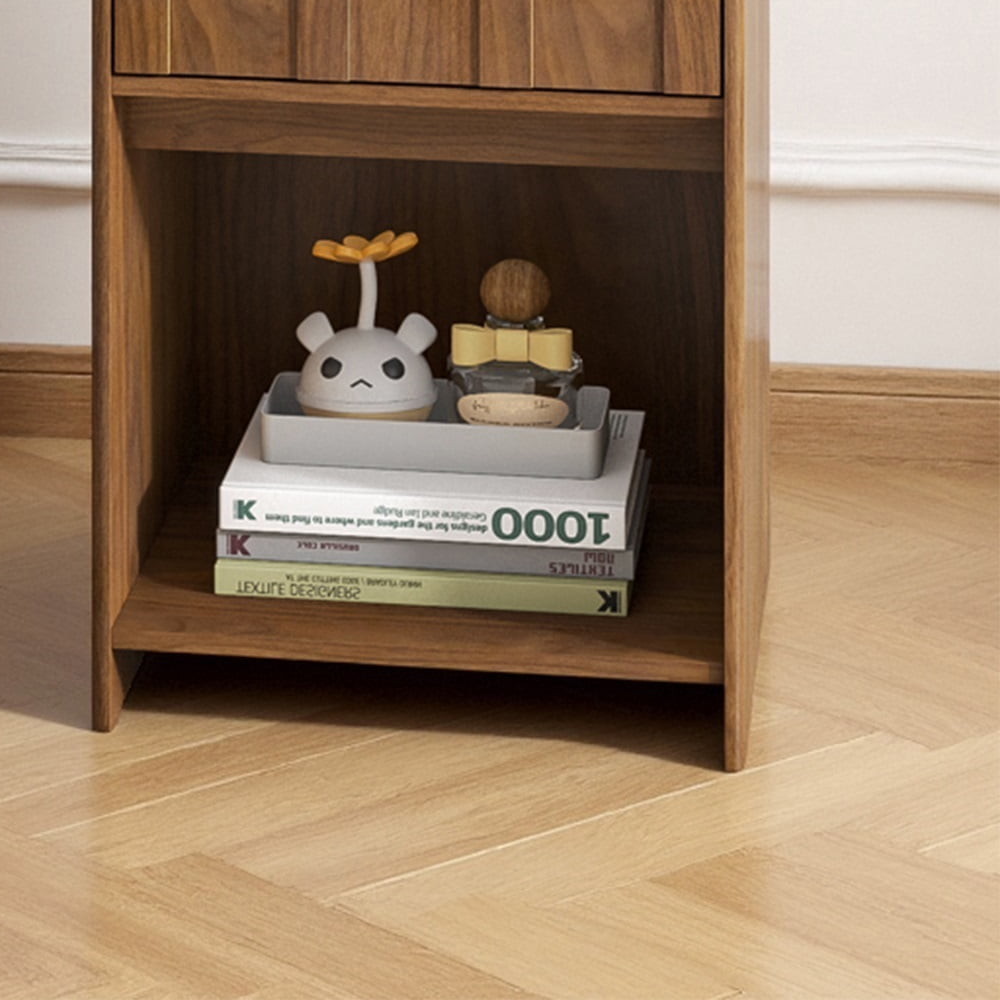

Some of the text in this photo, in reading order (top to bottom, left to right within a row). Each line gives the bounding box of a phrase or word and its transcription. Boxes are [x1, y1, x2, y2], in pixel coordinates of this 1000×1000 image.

[265, 513, 488, 534] designs for the gardens and where to find them
[374, 505, 487, 521] Geraldine and Ian Rudge
[491, 507, 610, 545] 1000
[549, 561, 615, 577] TEXTILES
[597, 590, 618, 613] K
